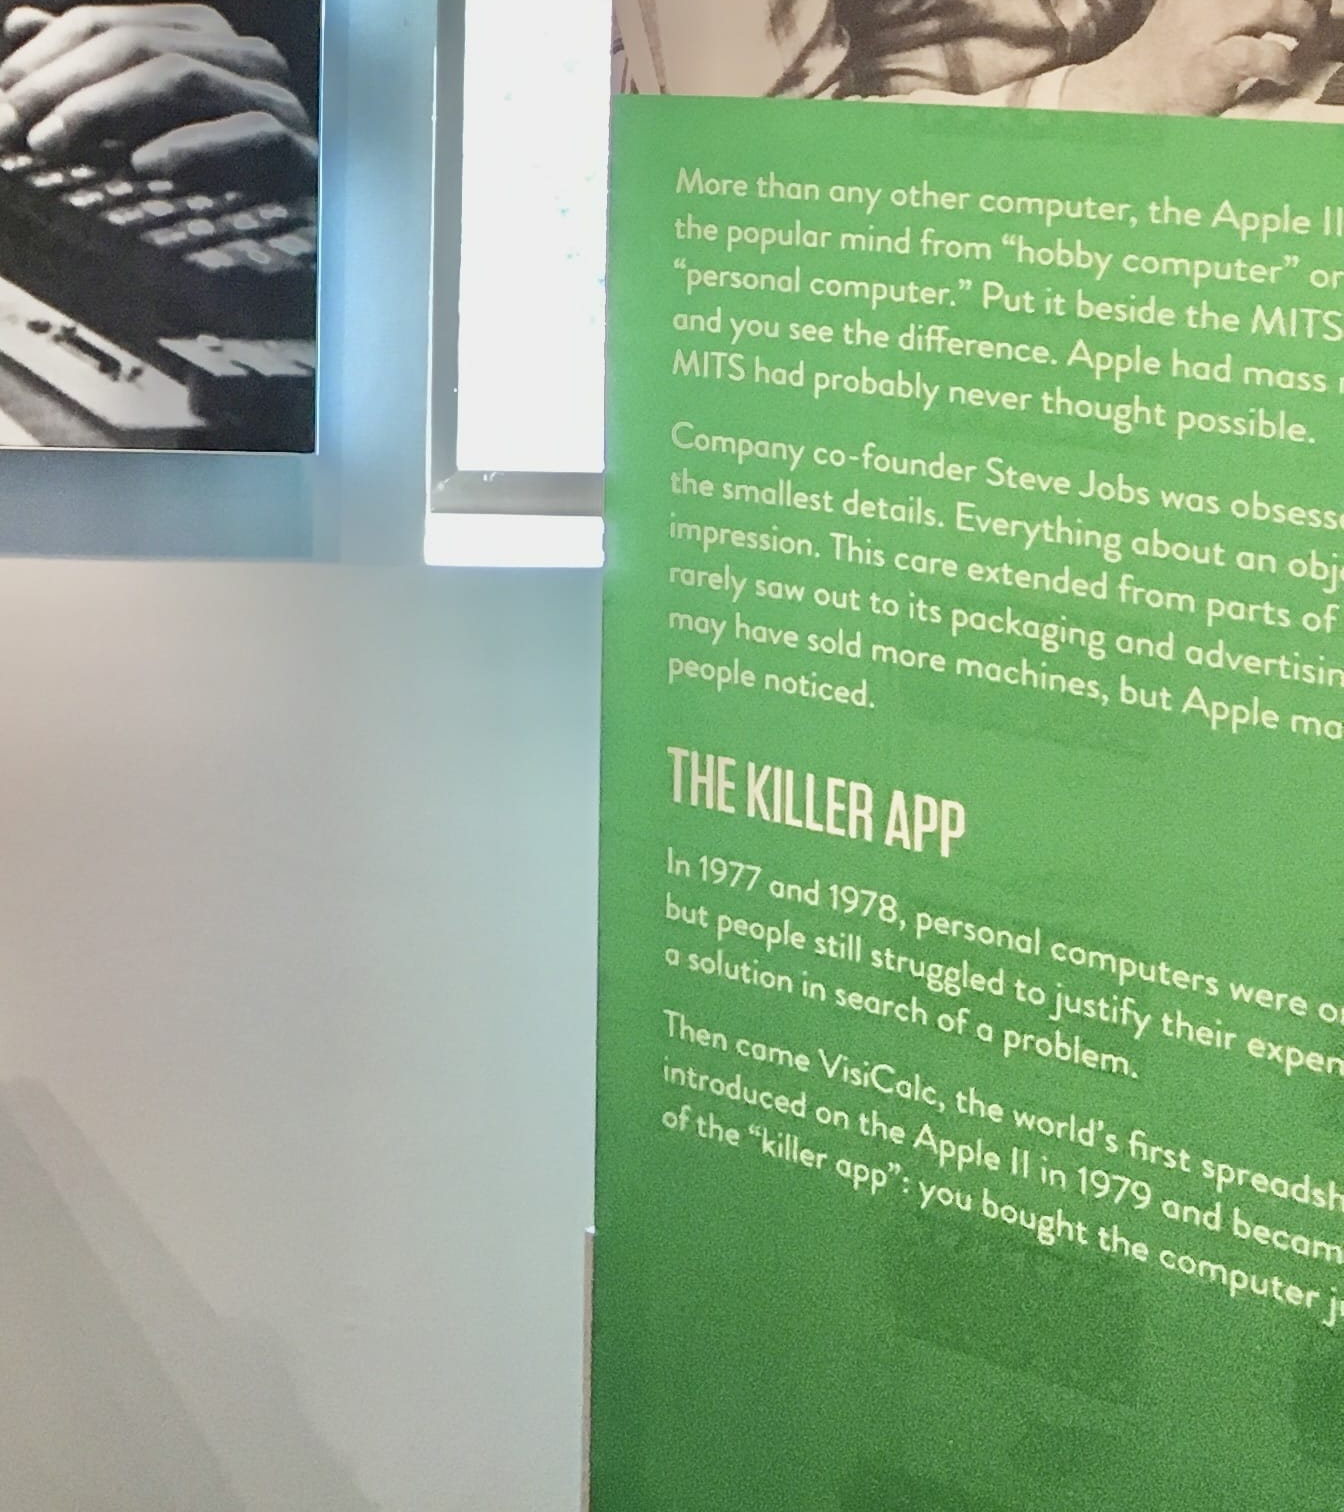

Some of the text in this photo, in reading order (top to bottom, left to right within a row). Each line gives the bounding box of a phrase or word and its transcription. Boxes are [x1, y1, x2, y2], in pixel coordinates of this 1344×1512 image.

[675, 213, 718, 241] the
[727, 219, 832, 255] popular
[840, 225, 911, 254] mind
[921, 227, 992, 260] from
[676, 167, 1343, 243] More than any other computer, the Apple II
[673, 349, 1315, 443] MITS had probably never thought possible.
[671, 422, 805, 469] Company
[813, 442, 977, 482] co-founder
[986, 457, 1071, 495] Steve
[1078, 470, 1150, 505] Jobs
[1160, 490, 1221, 514] was
[668, 657, 875, 708] people noticed.
[667, 747, 965, 858] THE KILLER APP
[667, 847, 690, 877] In
[699, 855, 762, 891] 1977
[770, 878, 820, 905] and
[829, 884, 906, 931] 1978,
[916, 912, 1040, 955] personal
[1051, 943, 1219, 996] computers
[1229, 982, 1307, 1016] were
[665, 948, 1138, 1078] a solution in search of a problem.
[663, 1009, 728, 1051] Then
[736, 1039, 810, 1072] came
[817, 1050, 945, 1112] VisiCalc,
[956, 1087, 1002, 1123] the
[1128, 1129, 1190, 1172] first
